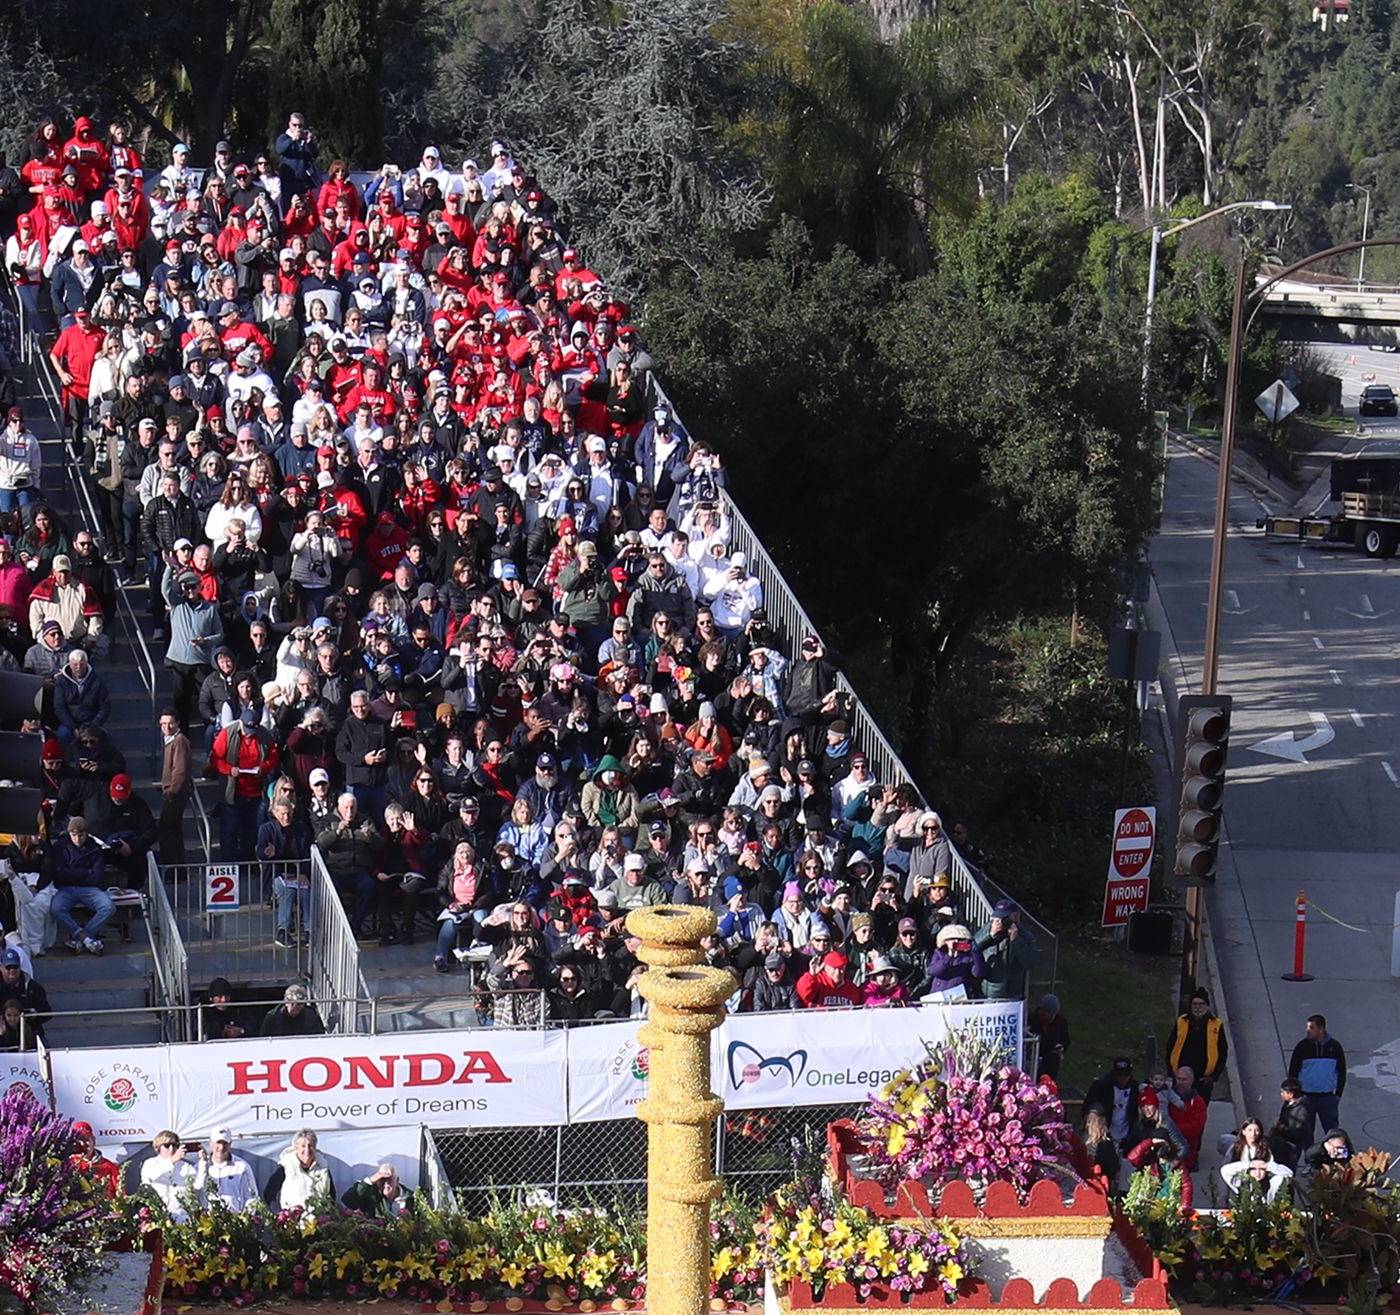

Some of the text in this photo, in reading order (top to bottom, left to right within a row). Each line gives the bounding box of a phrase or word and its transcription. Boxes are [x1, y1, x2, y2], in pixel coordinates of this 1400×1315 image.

[380, 544, 401, 557] UTAH
[1120, 821, 1149, 834] DO NOT
[1119, 853, 1144, 865] ENTER
[209, 867, 237, 876] AISLE
[211, 877, 235, 902] 2
[1111, 886, 1145, 901] WRONG
[964, 1014, 1017, 1027] HELPING
[612, 1039, 635, 1076] ROSE
[227, 1051, 512, 1095] HONDA
[806, 1067, 903, 1087] OneLegac
[84, 1063, 159, 1104] ROSE PARADE
[251, 1097, 488, 1121] The Power of Dreams
[100, 1128, 146, 1137] HONDA
